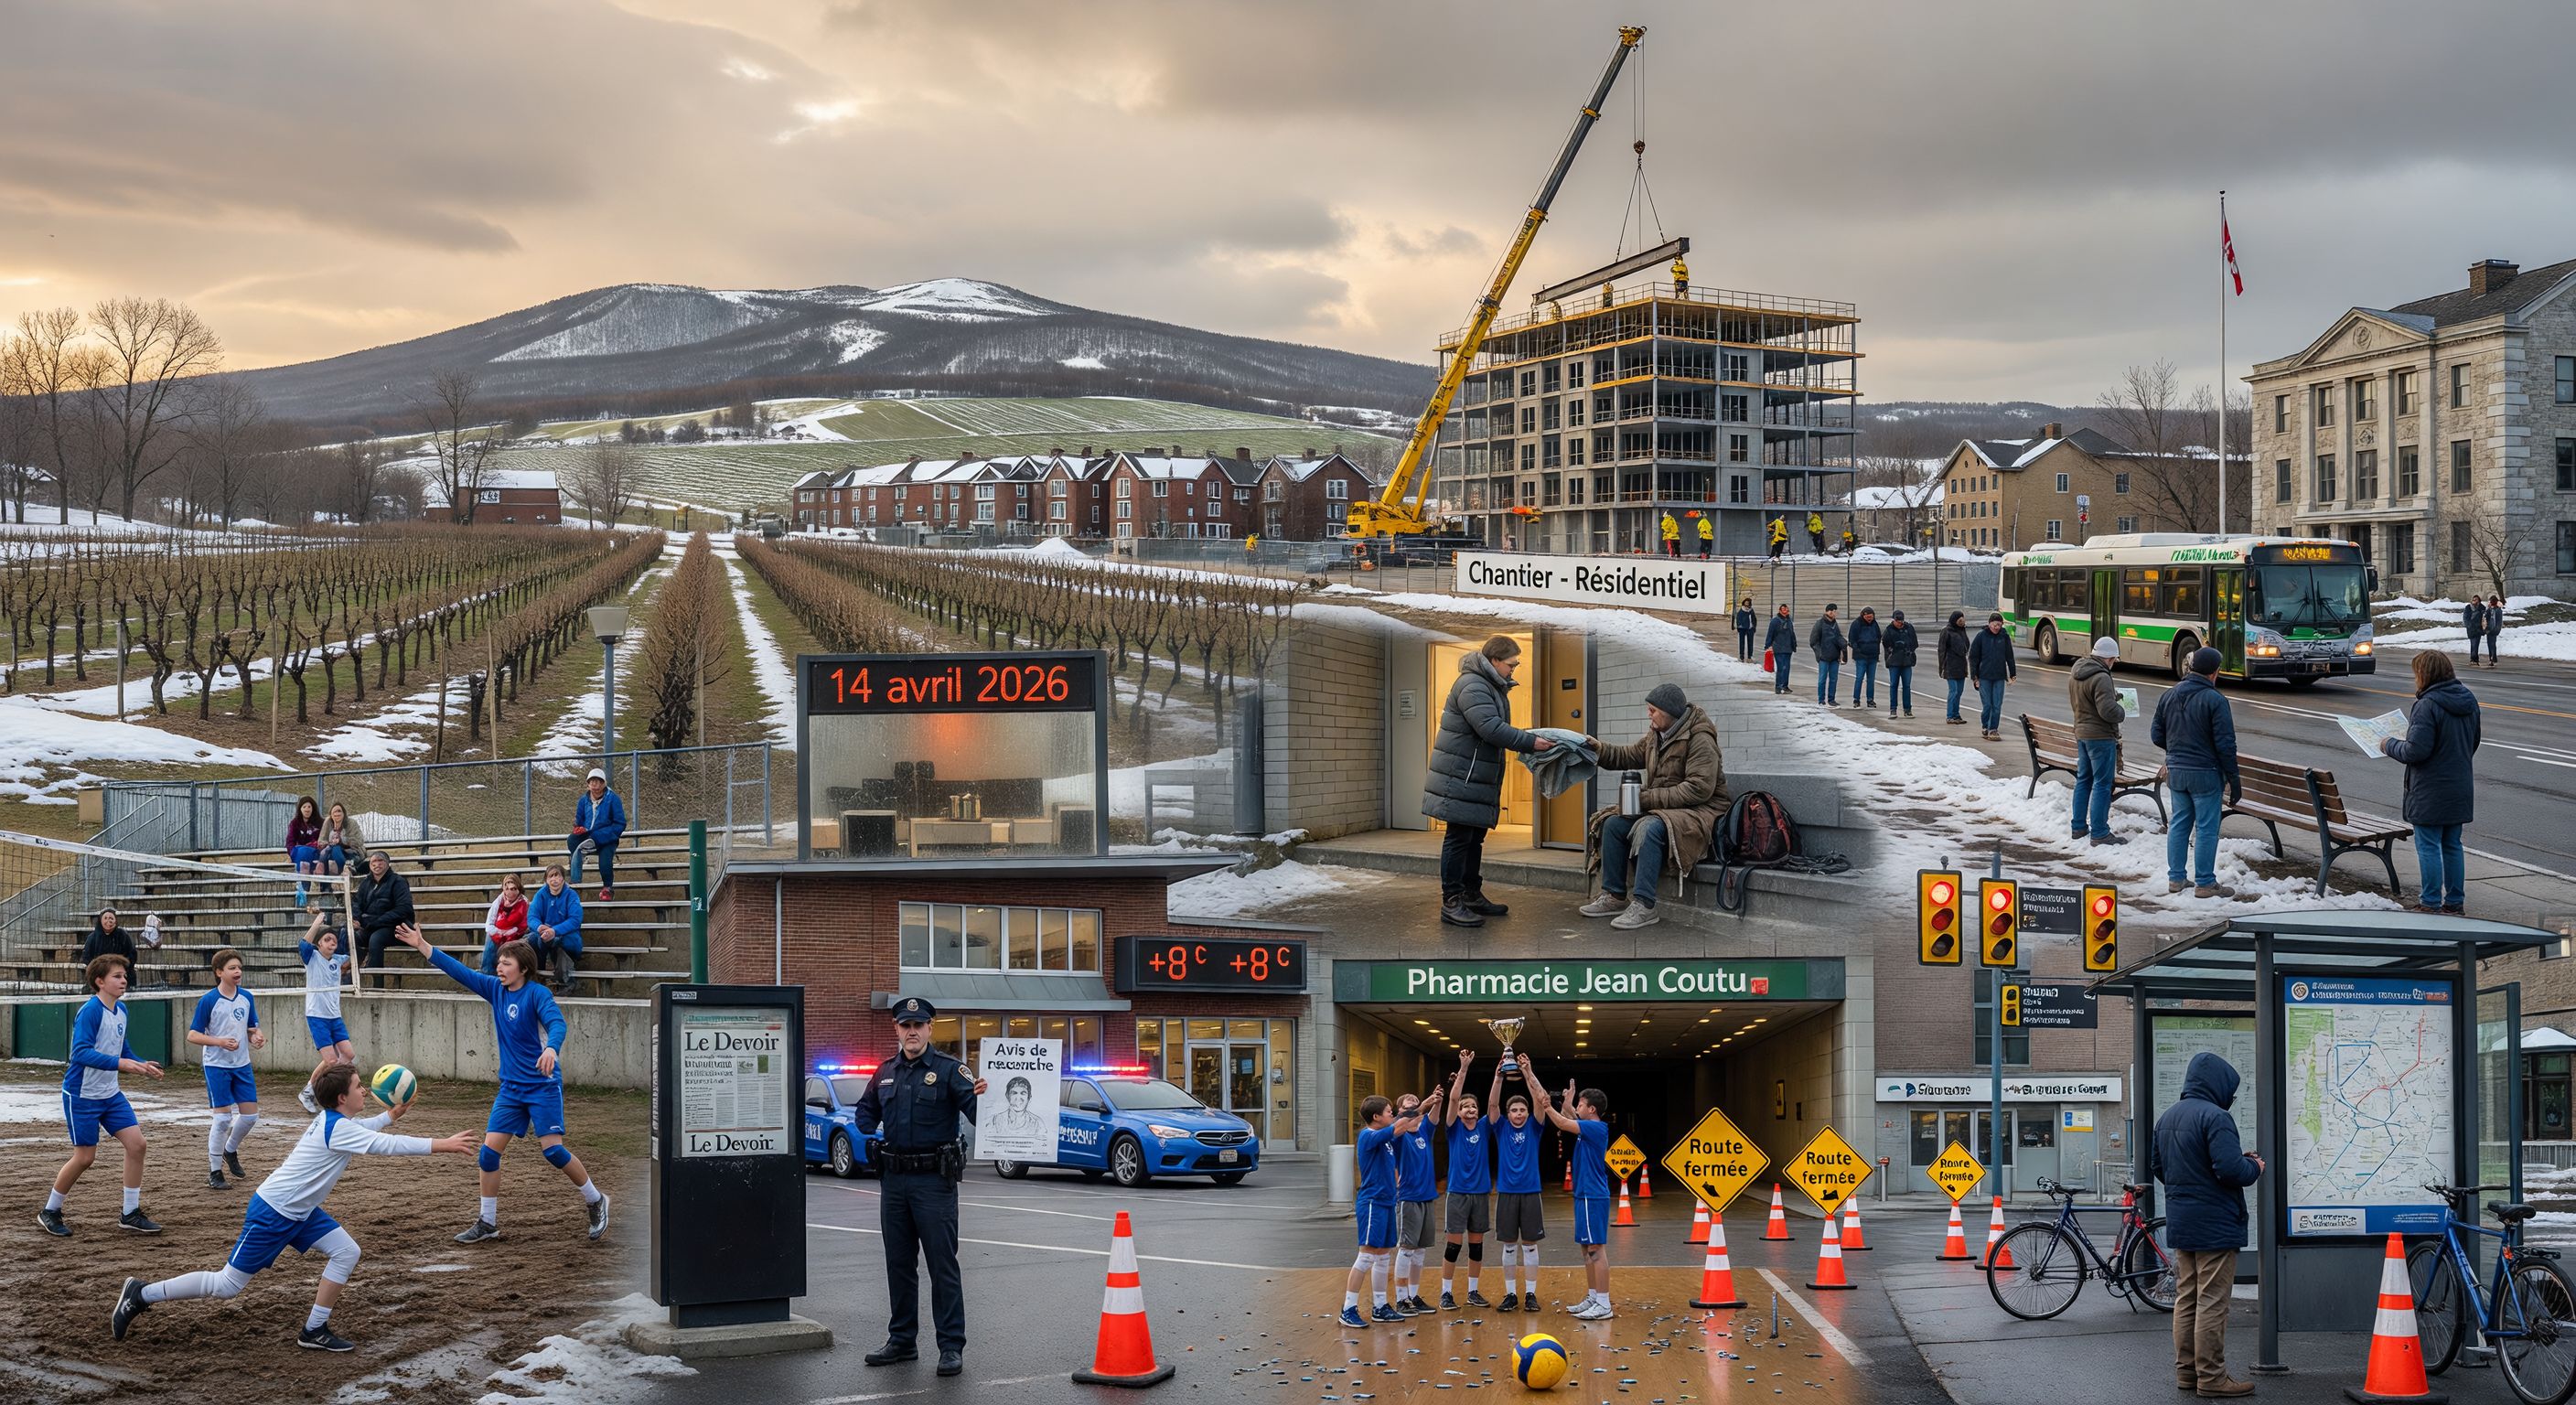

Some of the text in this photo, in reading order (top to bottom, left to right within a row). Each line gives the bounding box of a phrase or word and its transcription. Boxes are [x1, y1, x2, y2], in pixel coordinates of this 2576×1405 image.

[1468, 560, 1553, 589] Chantier
[1575, 565, 1706, 600] Résidentiel
[831, 665, 1069, 703] 14 avril 2026
[1408, 966, 1569, 995] Pharmacie
[1578, 967, 1648, 994] Jean
[1658, 966, 1746, 993] Coutu
[684, 1031, 779, 1052] Le Devoir
[994, 1043, 1047, 1056] Avis de
[689, 1133, 712, 1153] Le
[1690, 1138, 1744, 1154] Route
[1806, 1151, 1852, 1165] Route
[1683, 1160, 1748, 1177] fermée
[1802, 1171, 1856, 1185] fermée
